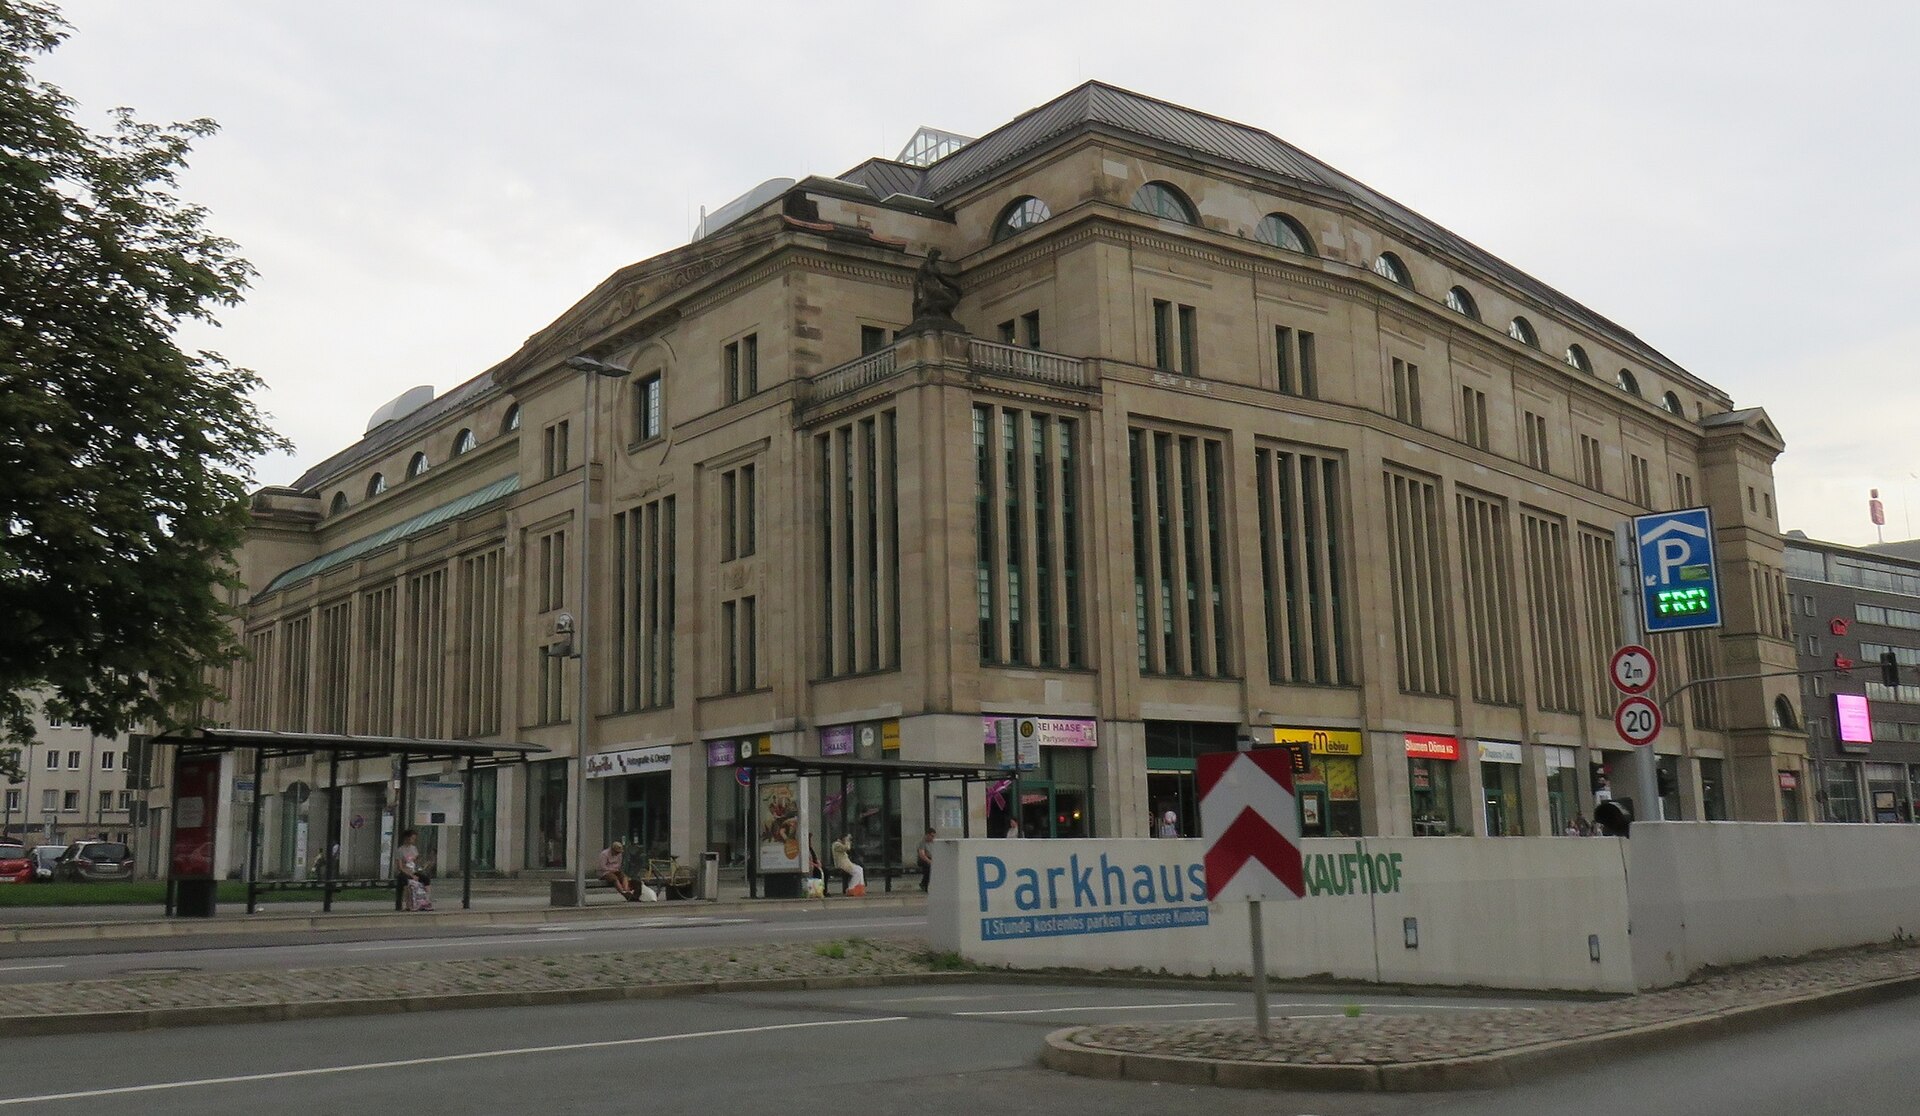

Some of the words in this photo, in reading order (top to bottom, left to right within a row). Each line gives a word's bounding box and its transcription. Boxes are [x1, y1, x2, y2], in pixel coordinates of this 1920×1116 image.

[1658, 538, 1691, 585] P
[1053, 723, 1080, 733] HAASE
[1625, 709, 1652, 733] 20
[1404, 739, 1428, 752] Blumen
[976, 853, 1207, 913] Parkhaus
[992, 919, 1031, 935] Stunde
[1033, 916, 1085, 933] kostenlos
[1086, 914, 1121, 933] parken
[1123, 912, 1138, 926] für
[1140, 913, 1172, 925] unsere
[1174, 909, 1207, 923] Kunden
